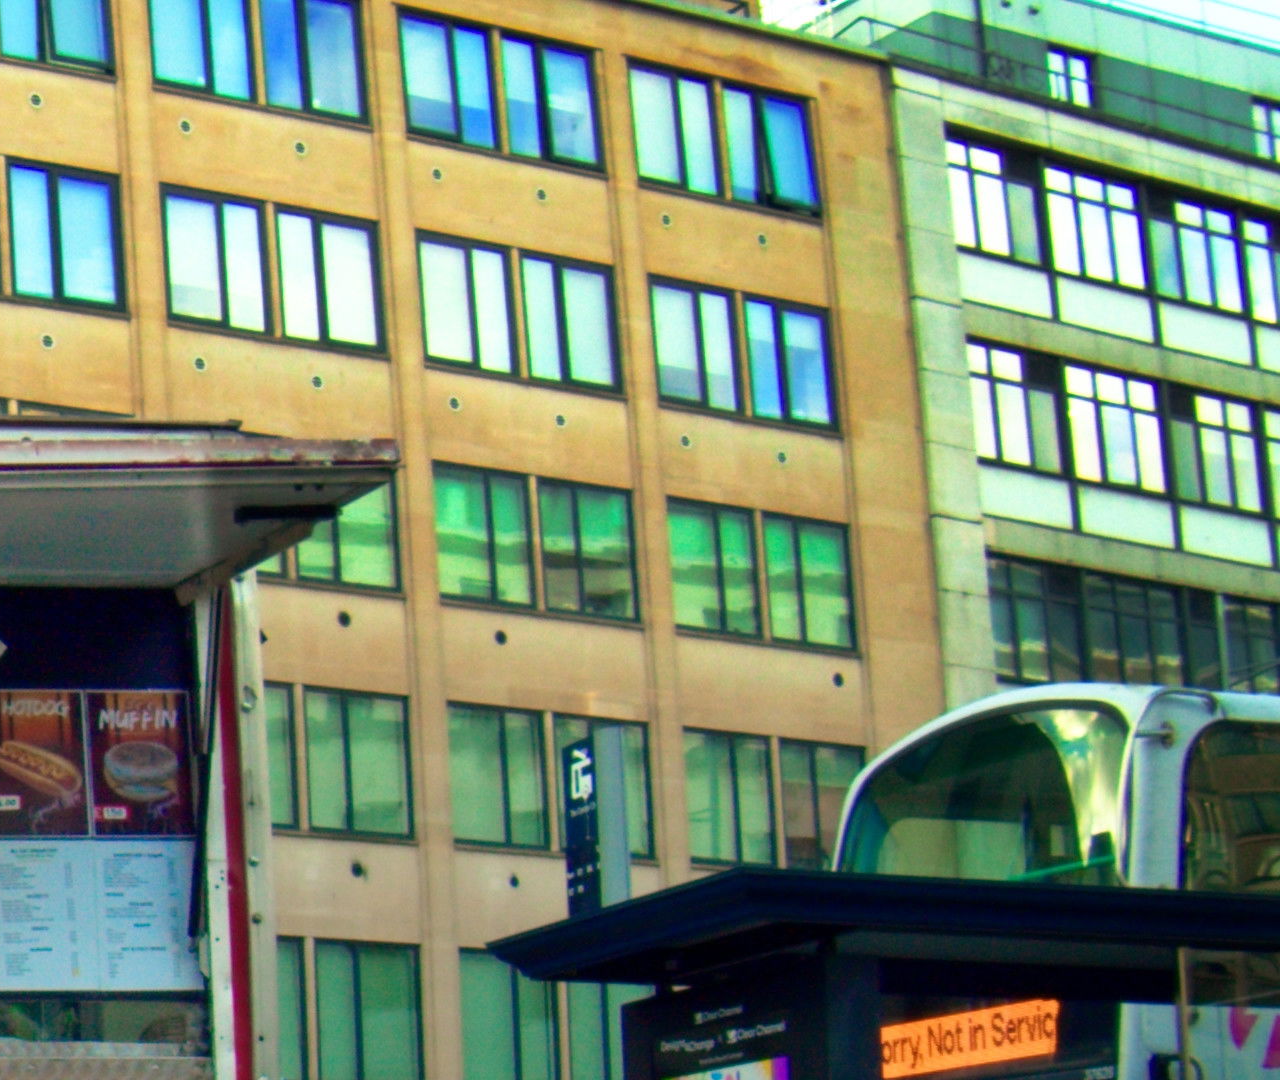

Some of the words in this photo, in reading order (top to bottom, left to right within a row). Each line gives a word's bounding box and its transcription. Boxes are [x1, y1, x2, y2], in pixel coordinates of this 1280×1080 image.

[98, 707, 178, 732] MUFFIN
[927, 1021, 963, 1058] Not
[968, 1017, 987, 1052] in
